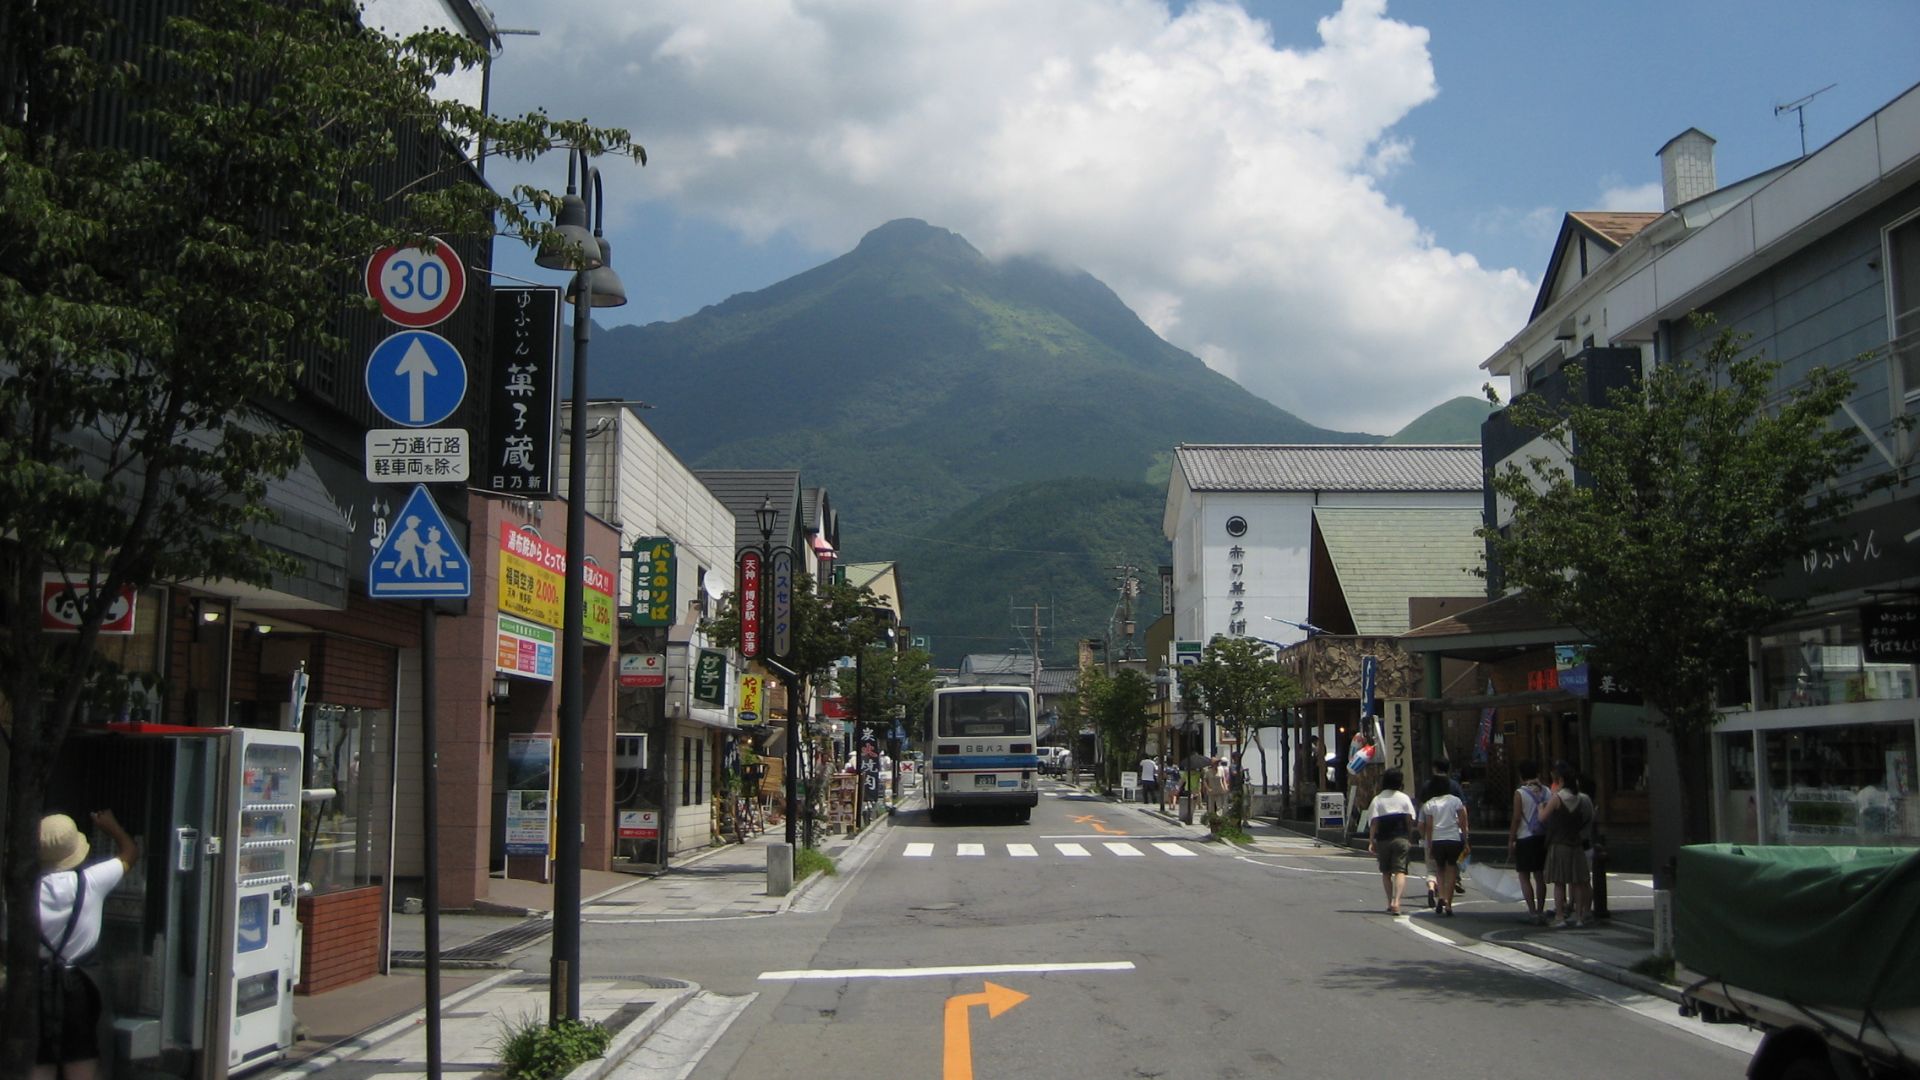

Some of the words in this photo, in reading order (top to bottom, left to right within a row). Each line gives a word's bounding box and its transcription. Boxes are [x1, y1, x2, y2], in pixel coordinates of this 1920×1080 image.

[390, 260, 443, 300] 30
[514, 291, 532, 356] ゆふいん
[502, 362, 539, 472] 菓子蔵
[374, 436, 460, 455] 一方通行路
[374, 458, 460, 476] 軽車両を除く
[1803, 529, 1880, 572] ゆふいん
[652, 543, 670, 620] バスのりば
[745, 559, 756, 652] 天神・博多駅・空港
[776, 560, 790, 650] バスセンター
[701, 656, 720, 699] サチコ
[860, 727, 878, 791] 炭火焼肉
[966, 744, 1004, 753] 日田バス
